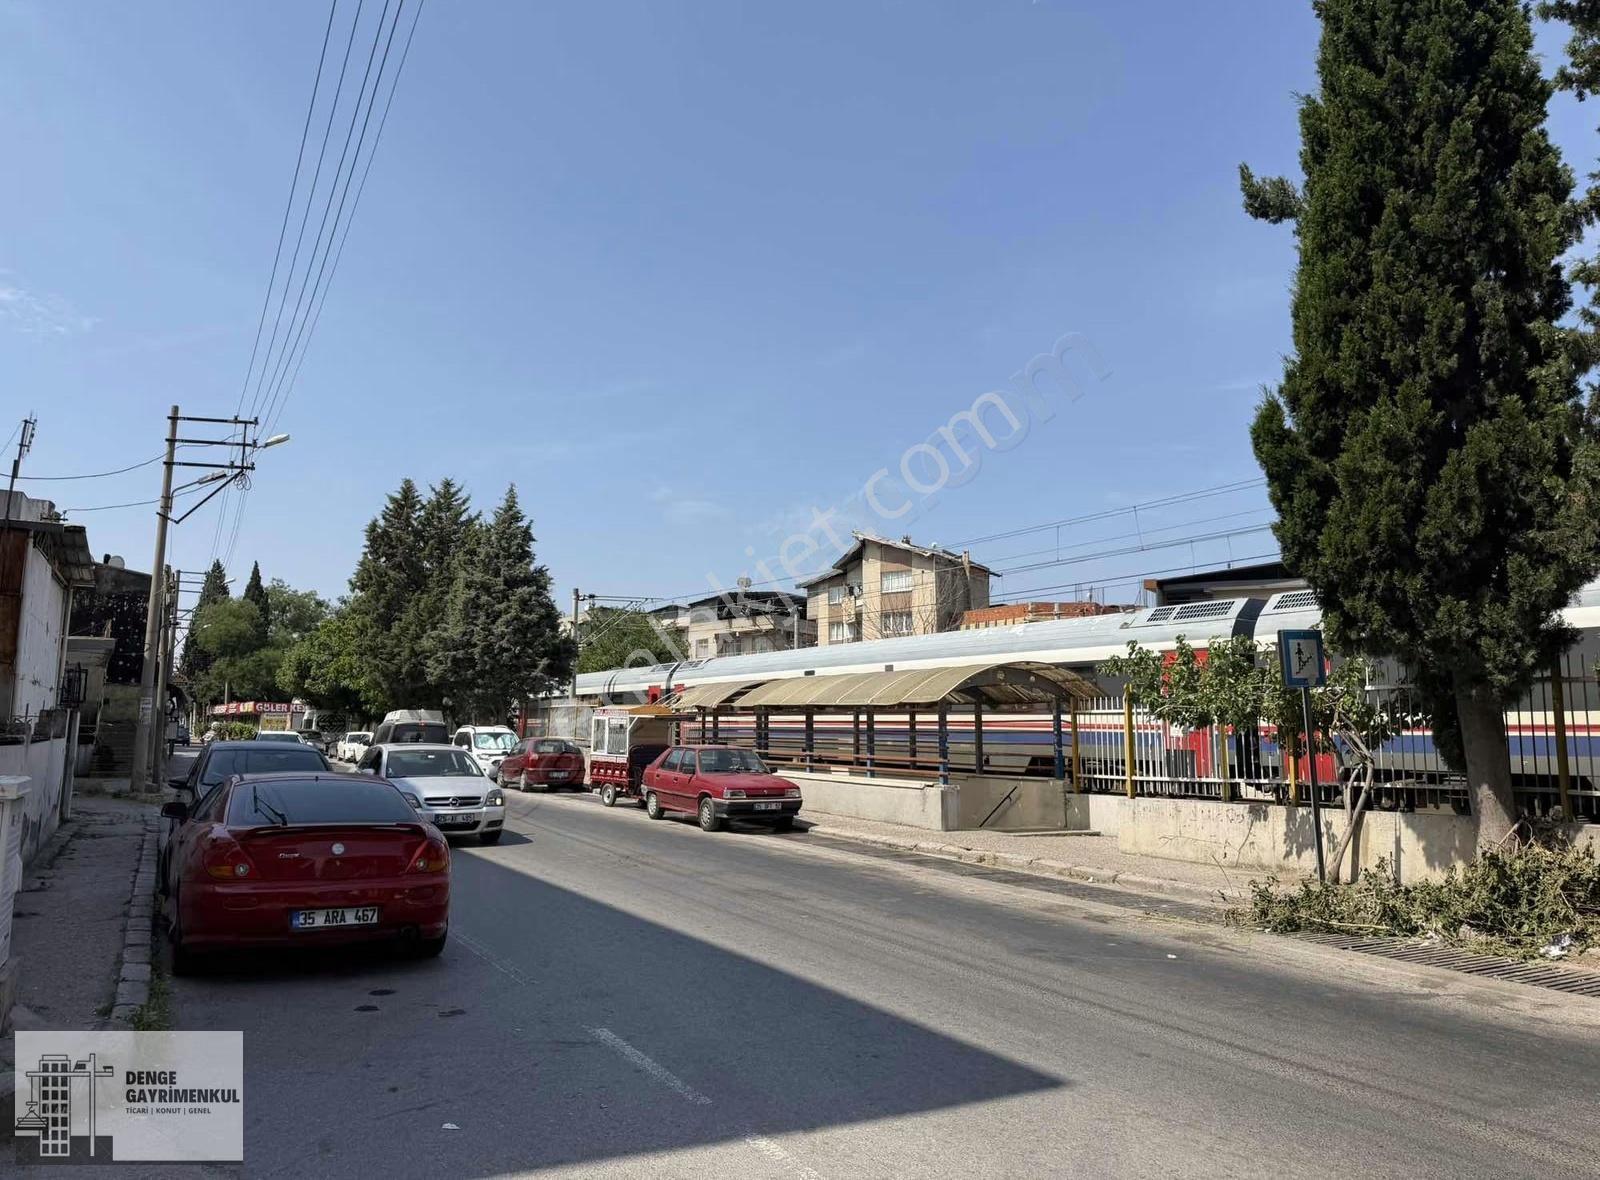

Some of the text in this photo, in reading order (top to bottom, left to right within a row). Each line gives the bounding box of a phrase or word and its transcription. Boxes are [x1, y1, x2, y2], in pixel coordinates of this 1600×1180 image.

[256, 703, 287, 713] GÜLER
[300, 908, 377, 926] 35 ARA 467
